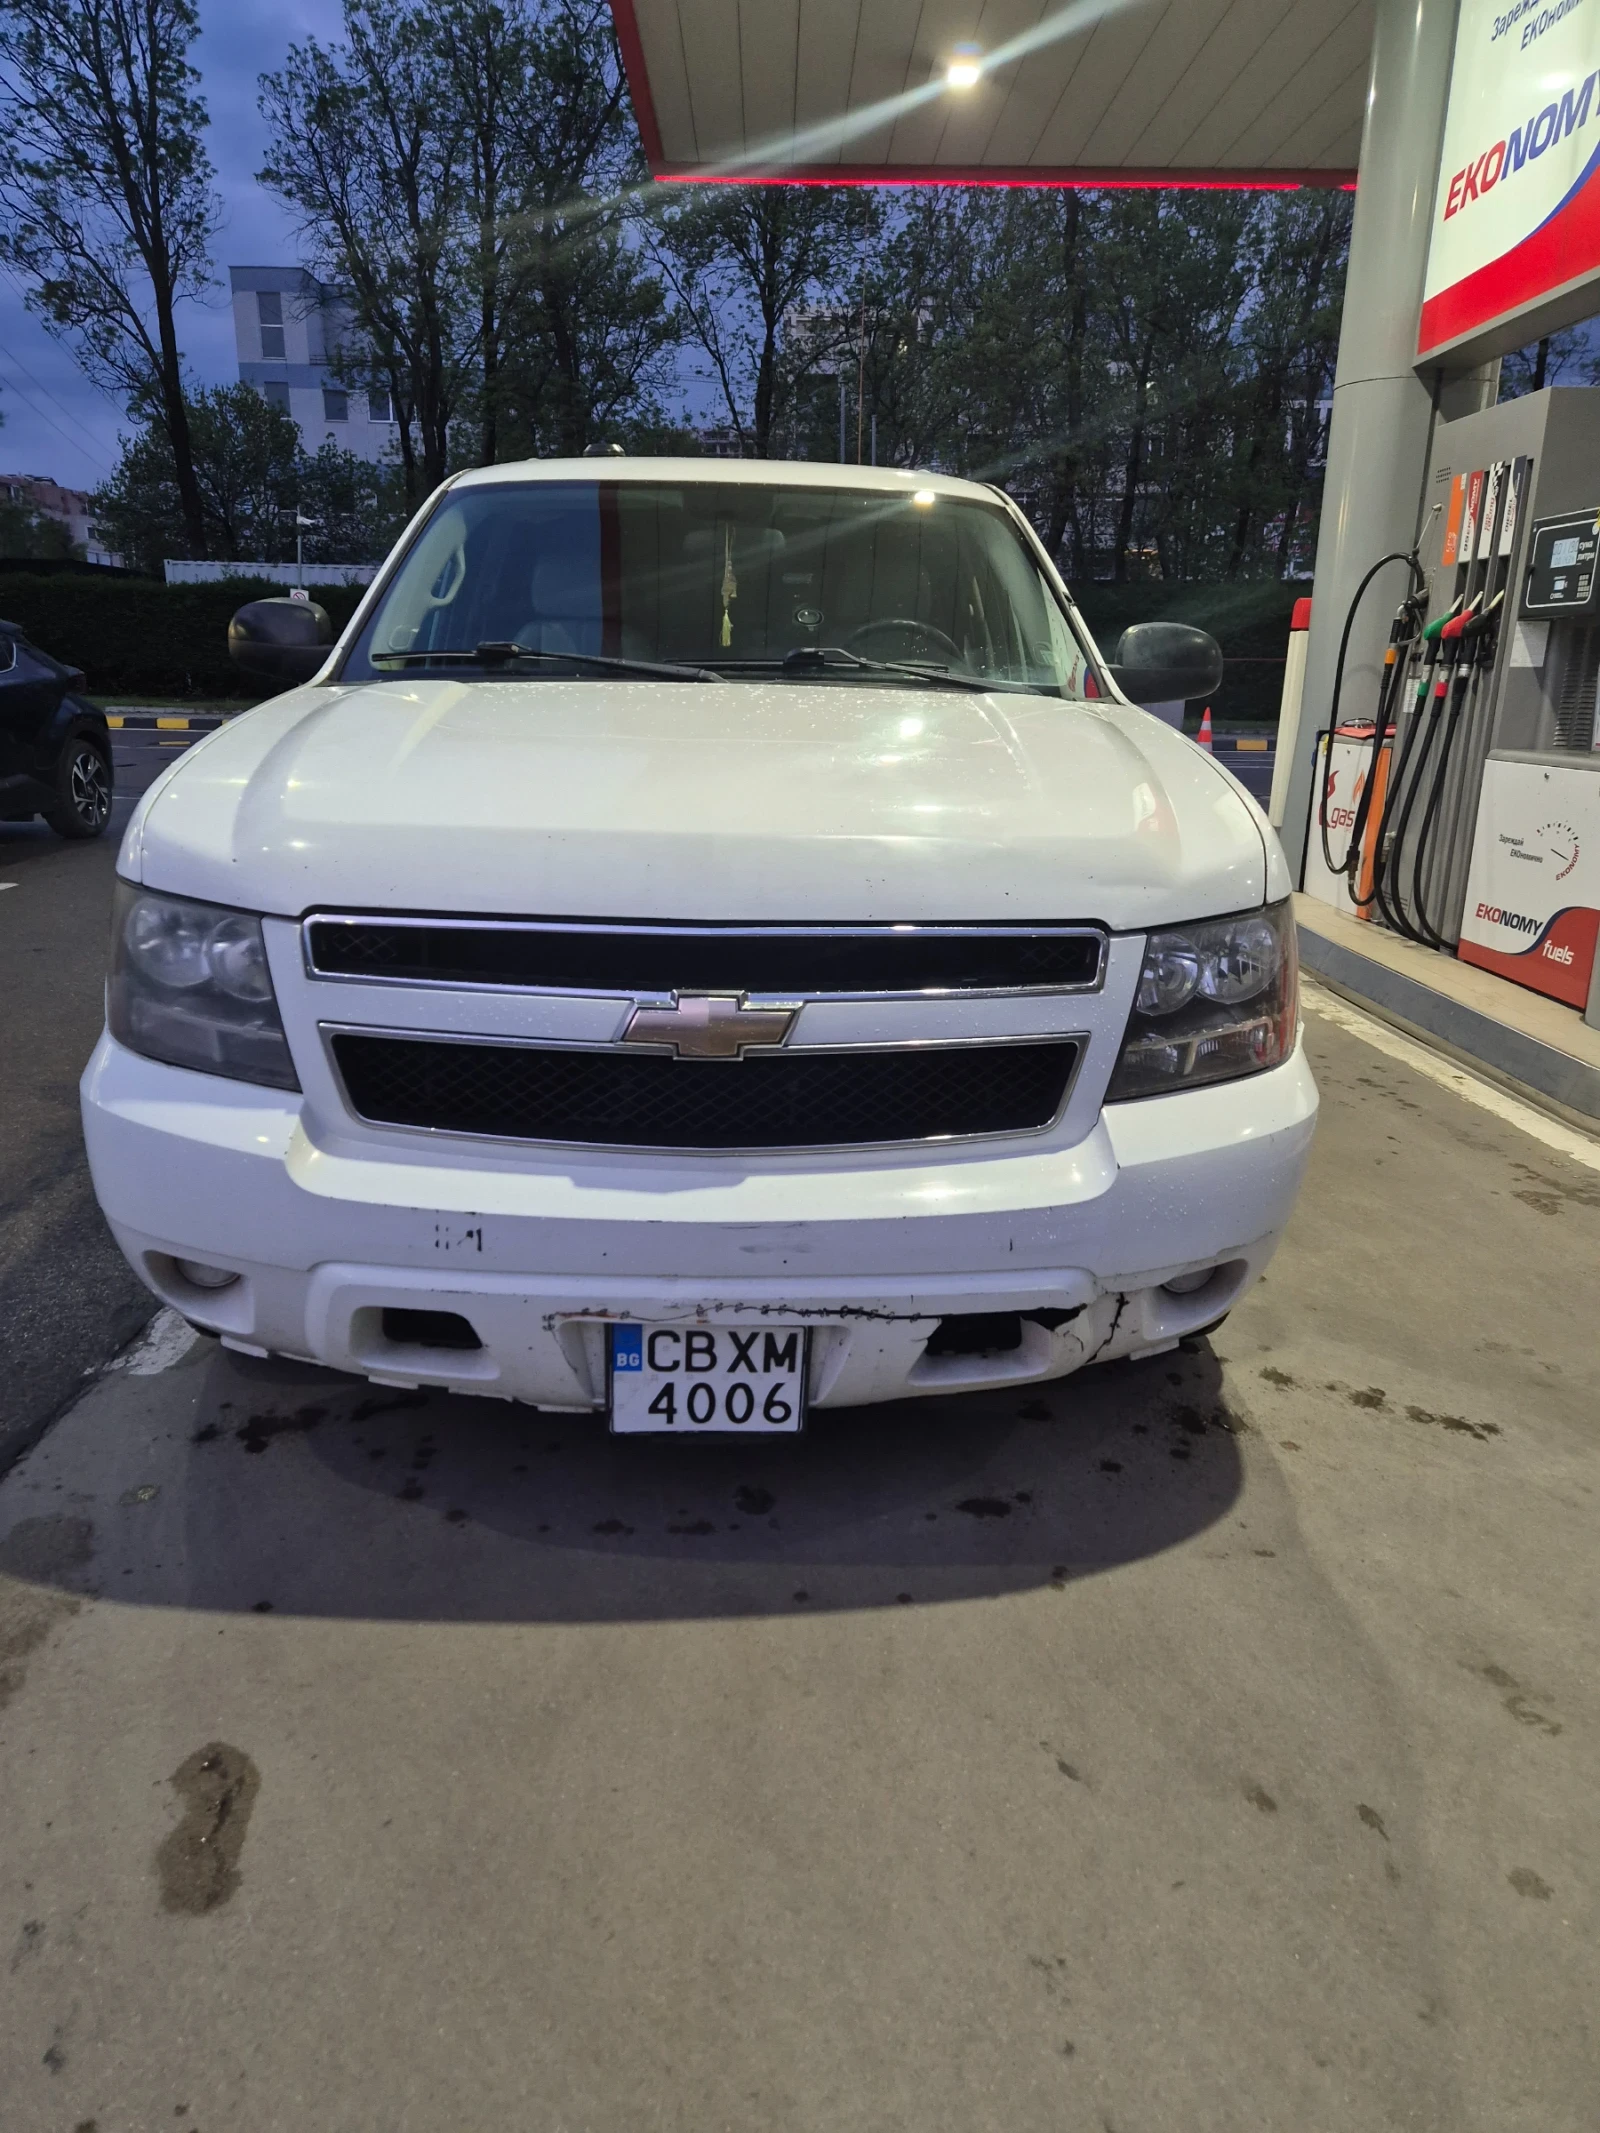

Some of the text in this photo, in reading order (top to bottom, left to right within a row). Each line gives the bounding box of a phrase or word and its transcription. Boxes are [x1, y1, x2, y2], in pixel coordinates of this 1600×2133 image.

[1331, 807, 1355, 829] gas
[1556, 843, 1580, 881] EKONOMY
[1475, 902, 1543, 936] EKONOMY
[1542, 939, 1574, 965] fuels
[616, 1353, 640, 1367] BG
[647, 1330, 798, 1373] CB XM
[648, 1382, 792, 1424] 4006
